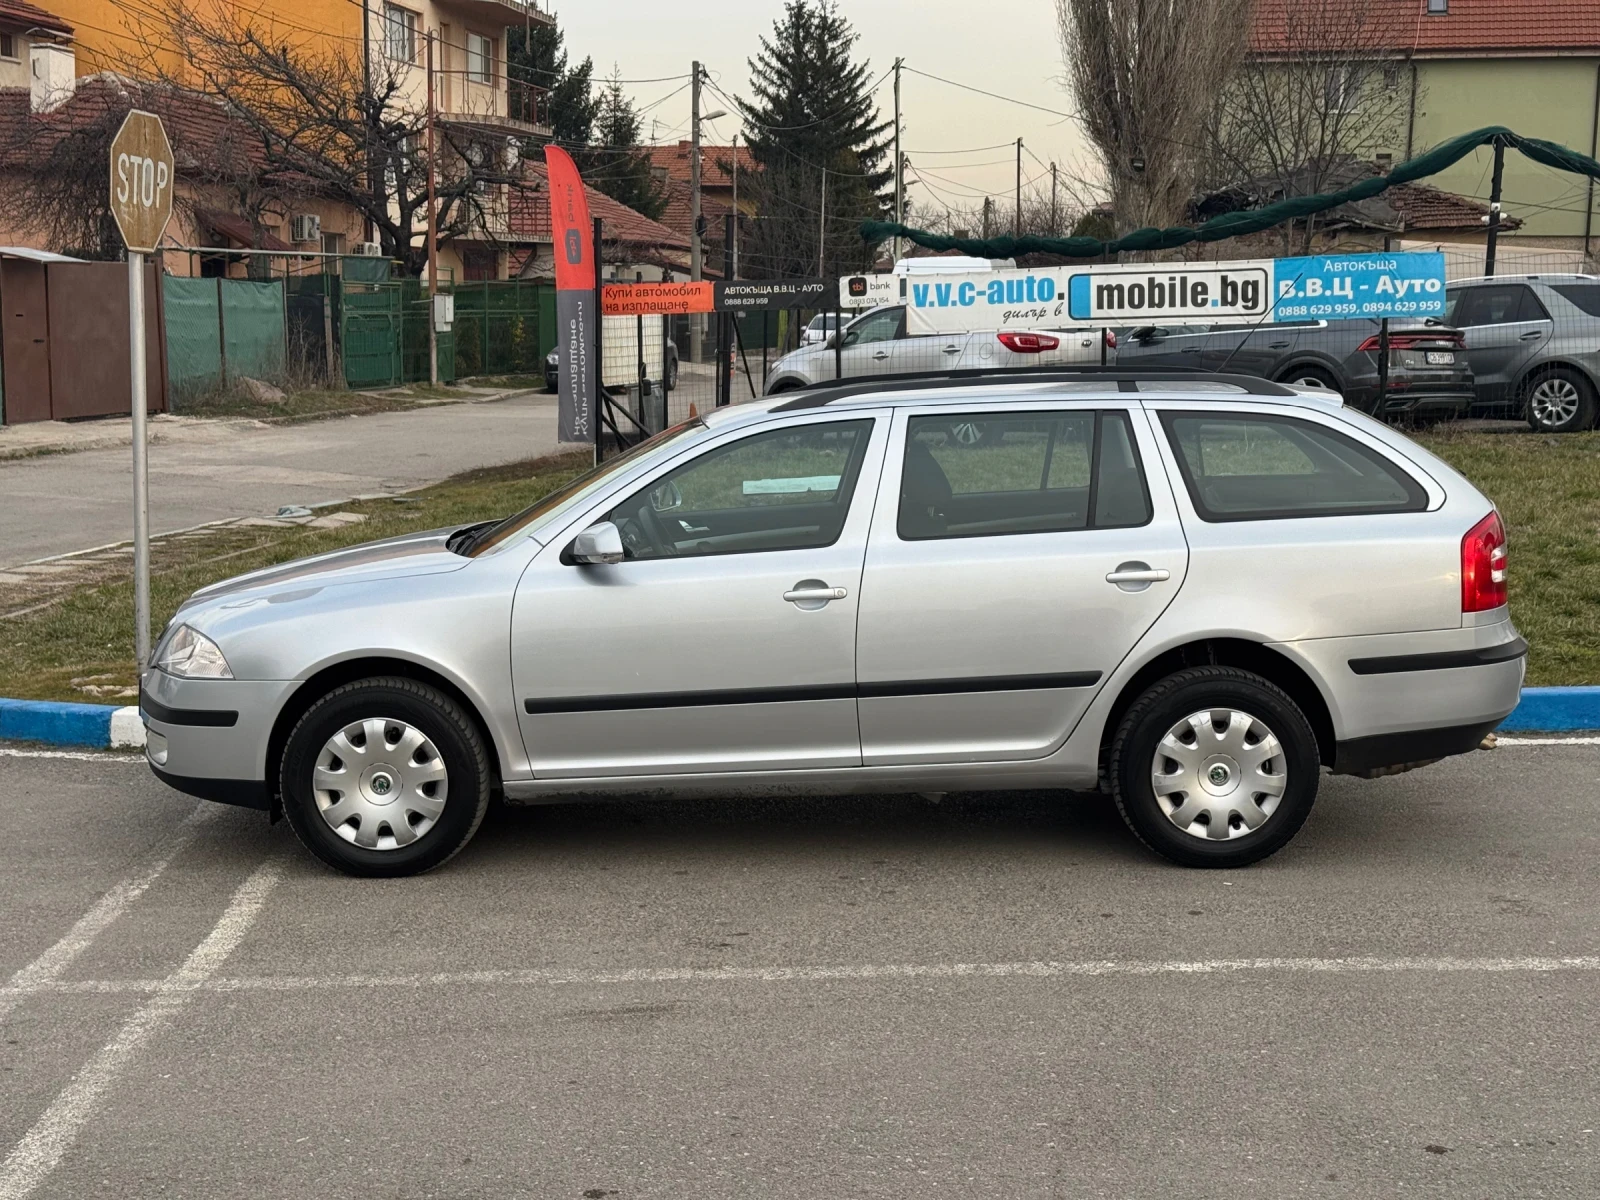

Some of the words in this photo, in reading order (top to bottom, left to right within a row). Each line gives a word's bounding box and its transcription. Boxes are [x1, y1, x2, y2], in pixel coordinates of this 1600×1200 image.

[117, 152, 168, 209] STOP
[1323, 259, 1397, 273] Автокъща
[605, 287, 633, 300] Купи
[635, 285, 701, 298] автомобил
[724, 285, 772, 295] АВТОКЪЩА
[773, 284, 796, 294] В.В.Ц
[801, 283, 824, 293] АУТО
[852, 282, 864, 291] tbi
[869, 281, 891, 290] bank
[1096, 274, 1259, 310] mobile.bg
[1279, 276, 1353, 299] В.В.Ц
[1375, 275, 1441, 299] Ауто
[606, 303, 620, 312] на
[622, 301, 689, 312] изплащане
[724, 298, 742, 306] 0888
[1278, 305, 1308, 317] 0888
[1310, 304, 1333, 315] 629
[1334, 303, 1360, 315] 959,
[1362, 301, 1392, 313] 0894
[1394, 301, 1417, 312] 629
[1419, 300, 1442, 311] 959
